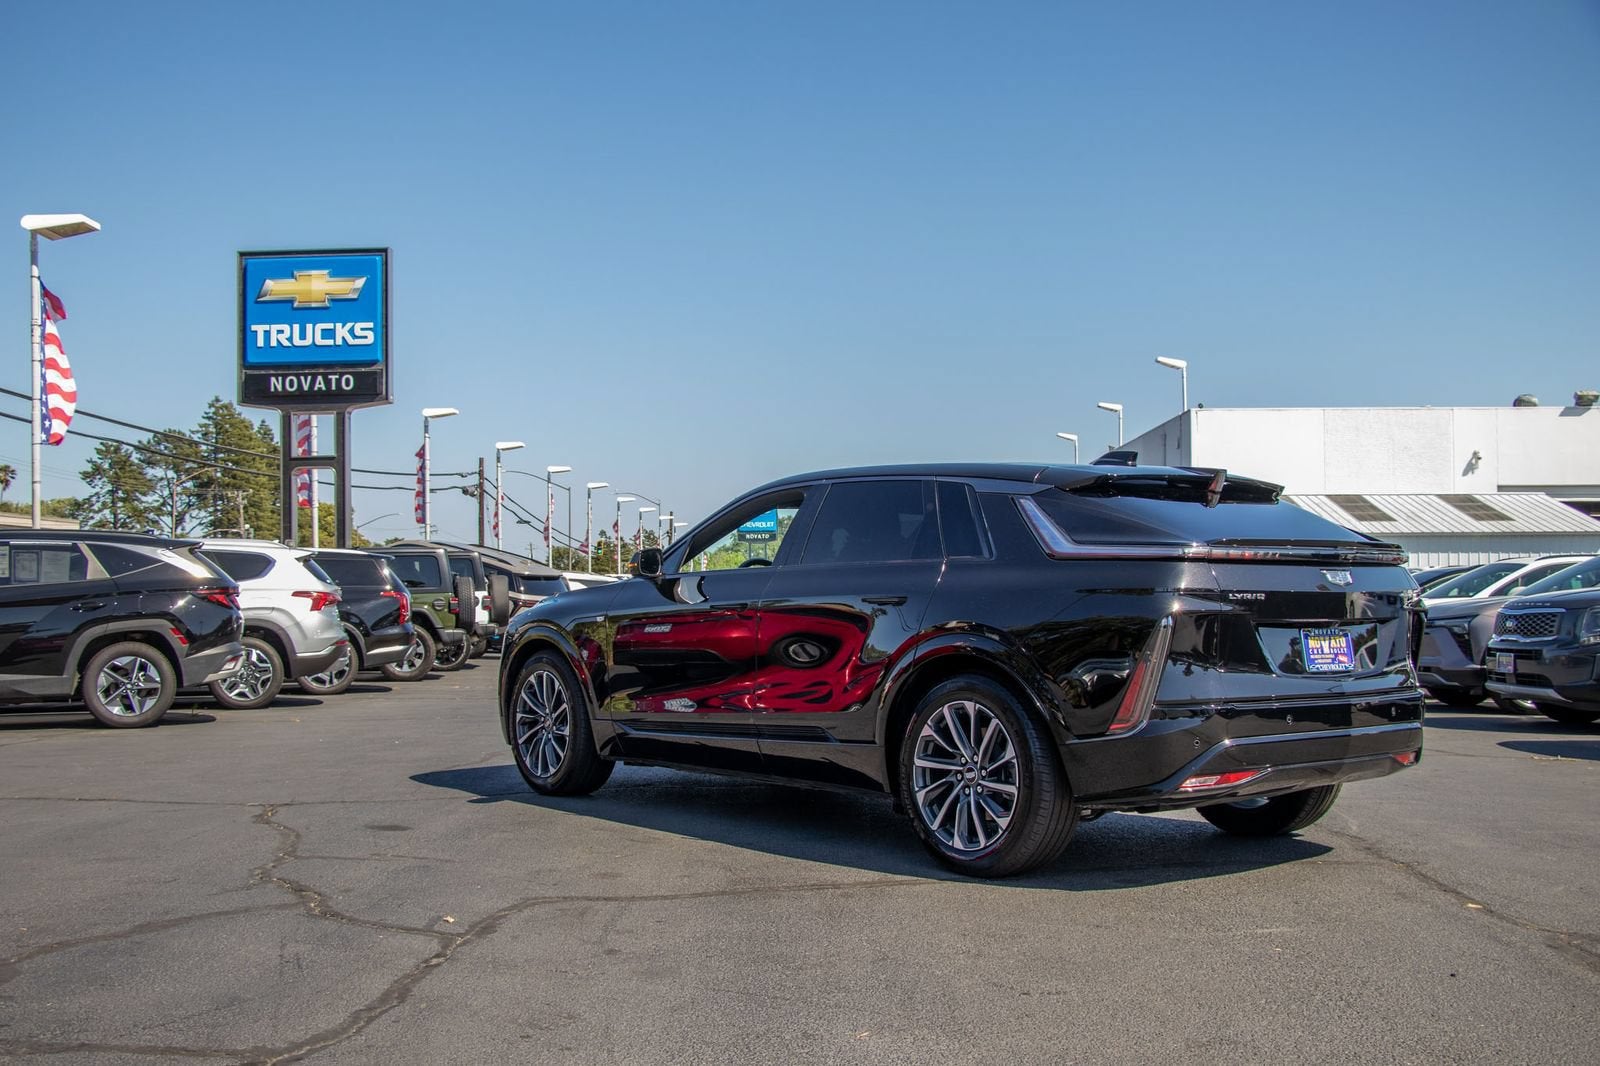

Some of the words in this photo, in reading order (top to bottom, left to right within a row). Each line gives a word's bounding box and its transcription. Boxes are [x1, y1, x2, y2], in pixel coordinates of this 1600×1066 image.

[251, 322, 375, 347] TRUCKS
[270, 374, 354, 392] NOVATO
[1308, 636, 1347, 651] NOVATO
